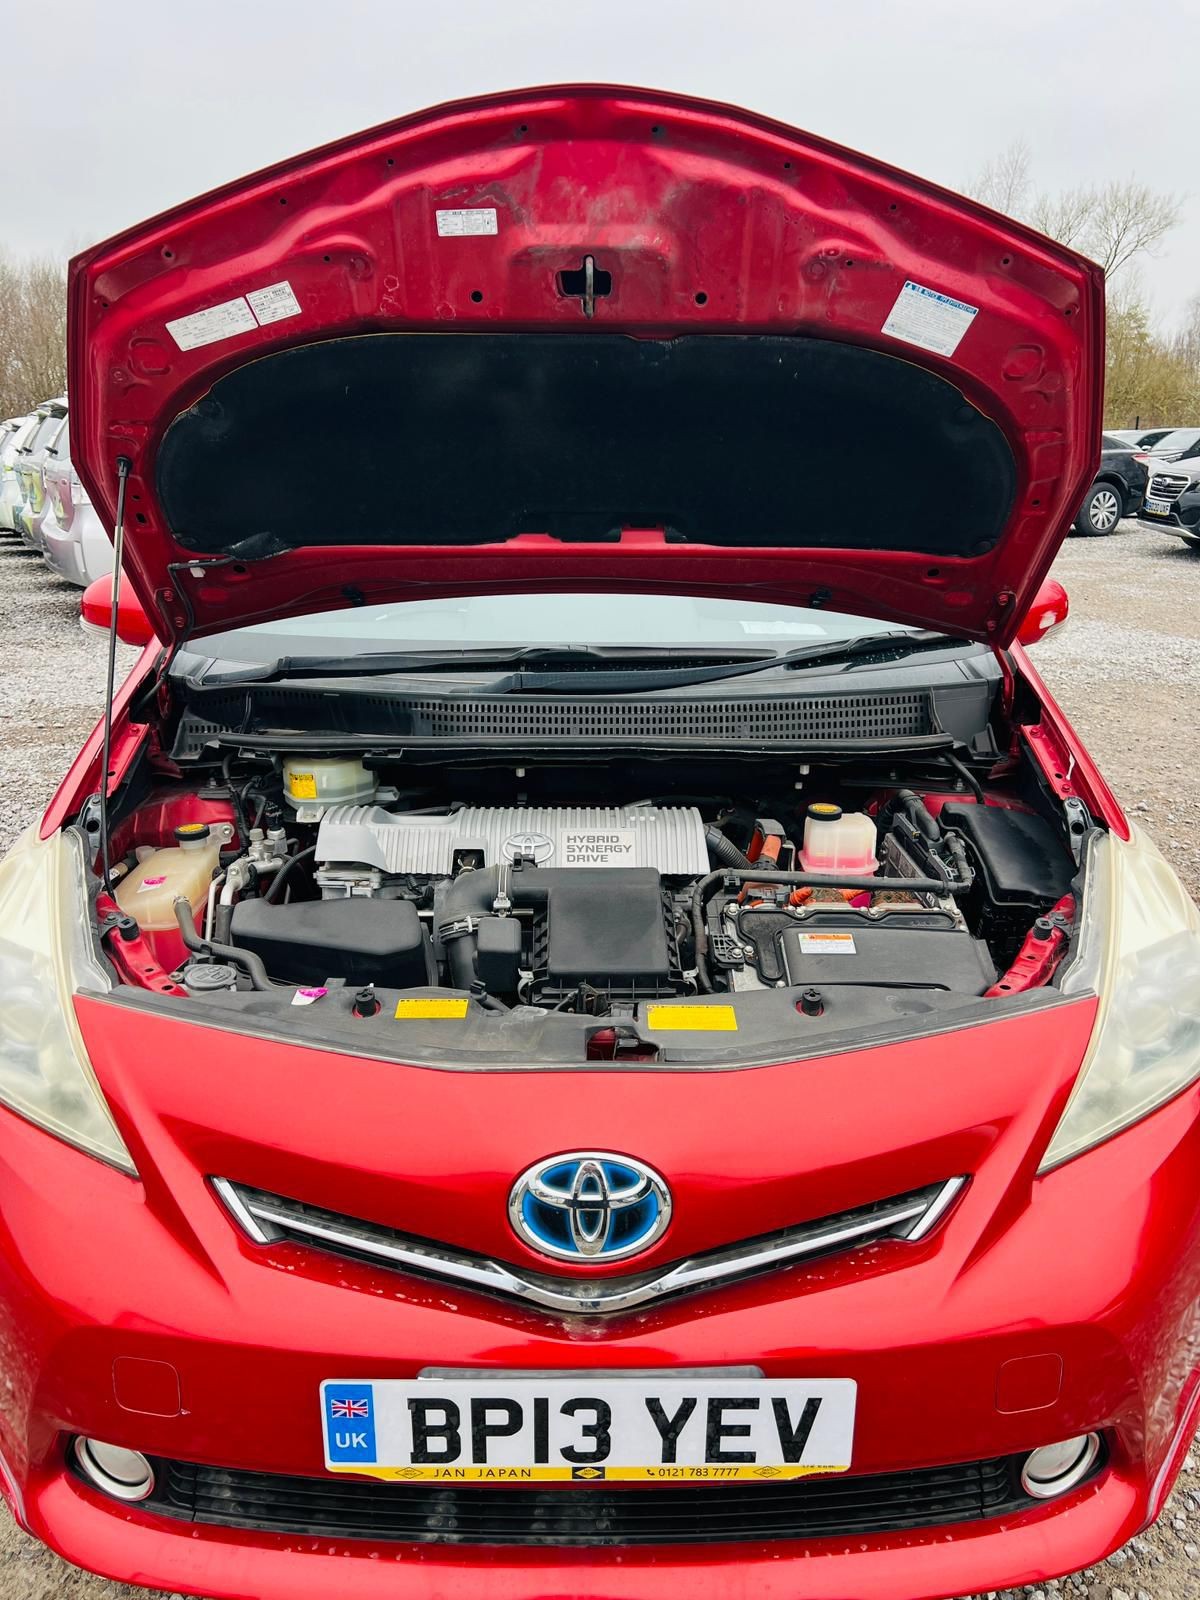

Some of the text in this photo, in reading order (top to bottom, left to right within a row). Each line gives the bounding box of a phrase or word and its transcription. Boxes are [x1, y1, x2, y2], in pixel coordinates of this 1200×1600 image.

[566, 835, 620, 844] HYBRID
[566, 844, 632, 853] SYNERGY
[566, 854, 609, 863] DRIVE
[407, 1397, 823, 1464] BP13 YEV
[335, 1432, 368, 1449] UK
[433, 1468, 532, 1478] JAN JAPAN
[658, 1467, 740, 1477] 0121 783 7777
